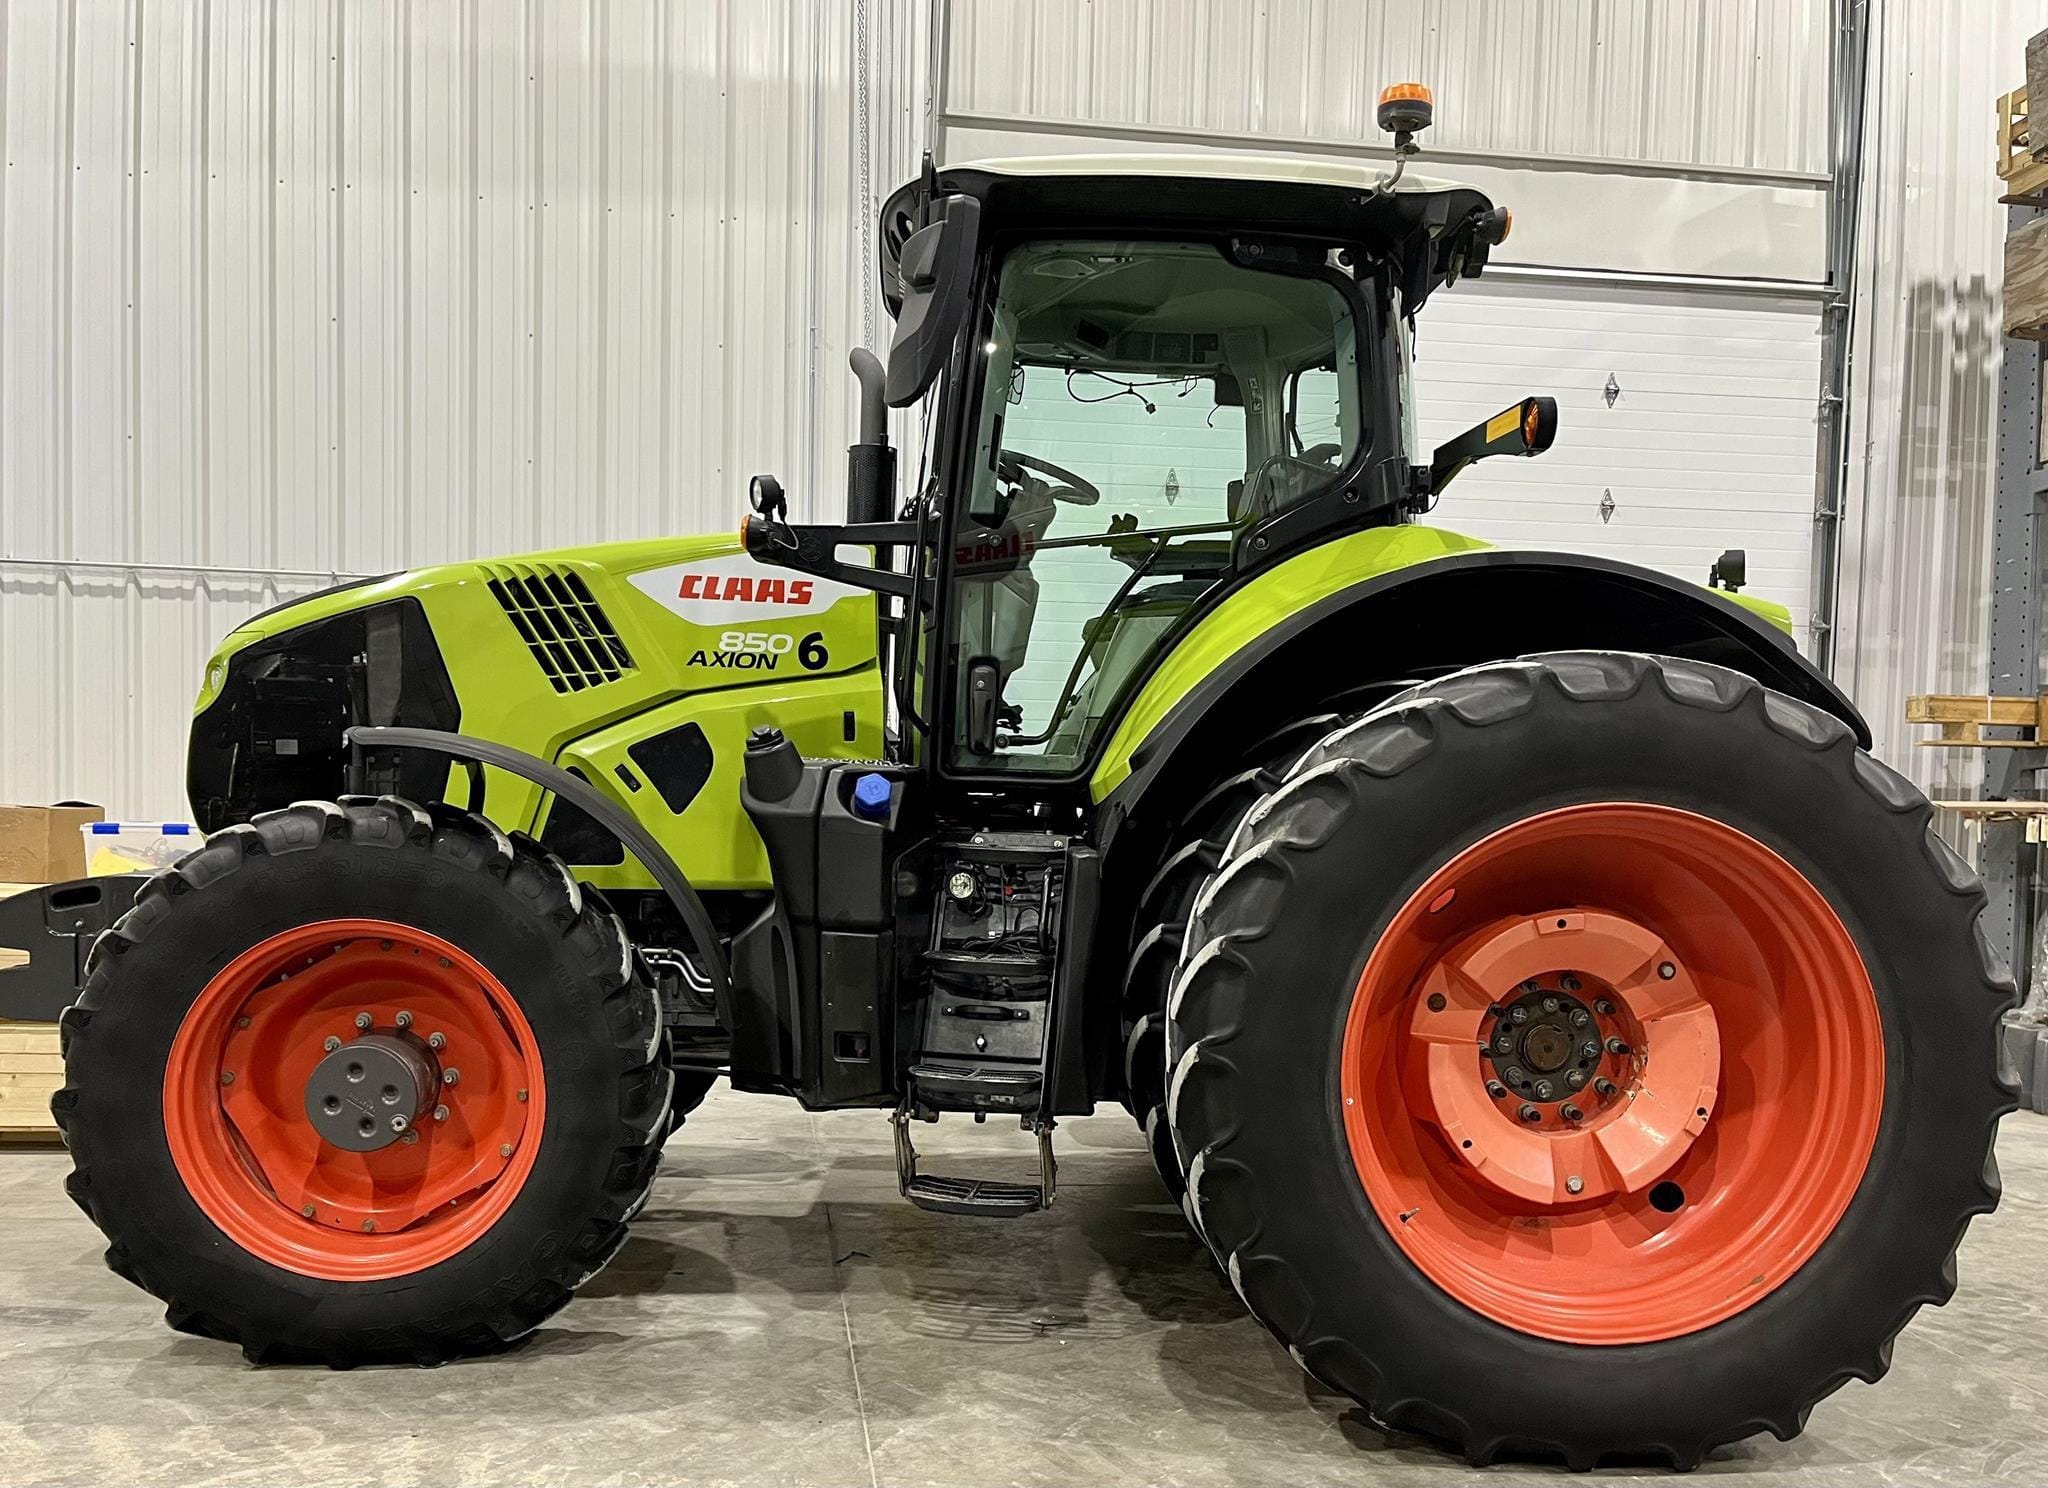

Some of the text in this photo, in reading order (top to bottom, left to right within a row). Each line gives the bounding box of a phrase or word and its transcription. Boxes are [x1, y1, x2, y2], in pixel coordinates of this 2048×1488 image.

[678, 575, 813, 605] CLAAS
[718, 631, 794, 654] 850
[797, 632, 829, 670] 6
[686, 650, 779, 670] AXION
